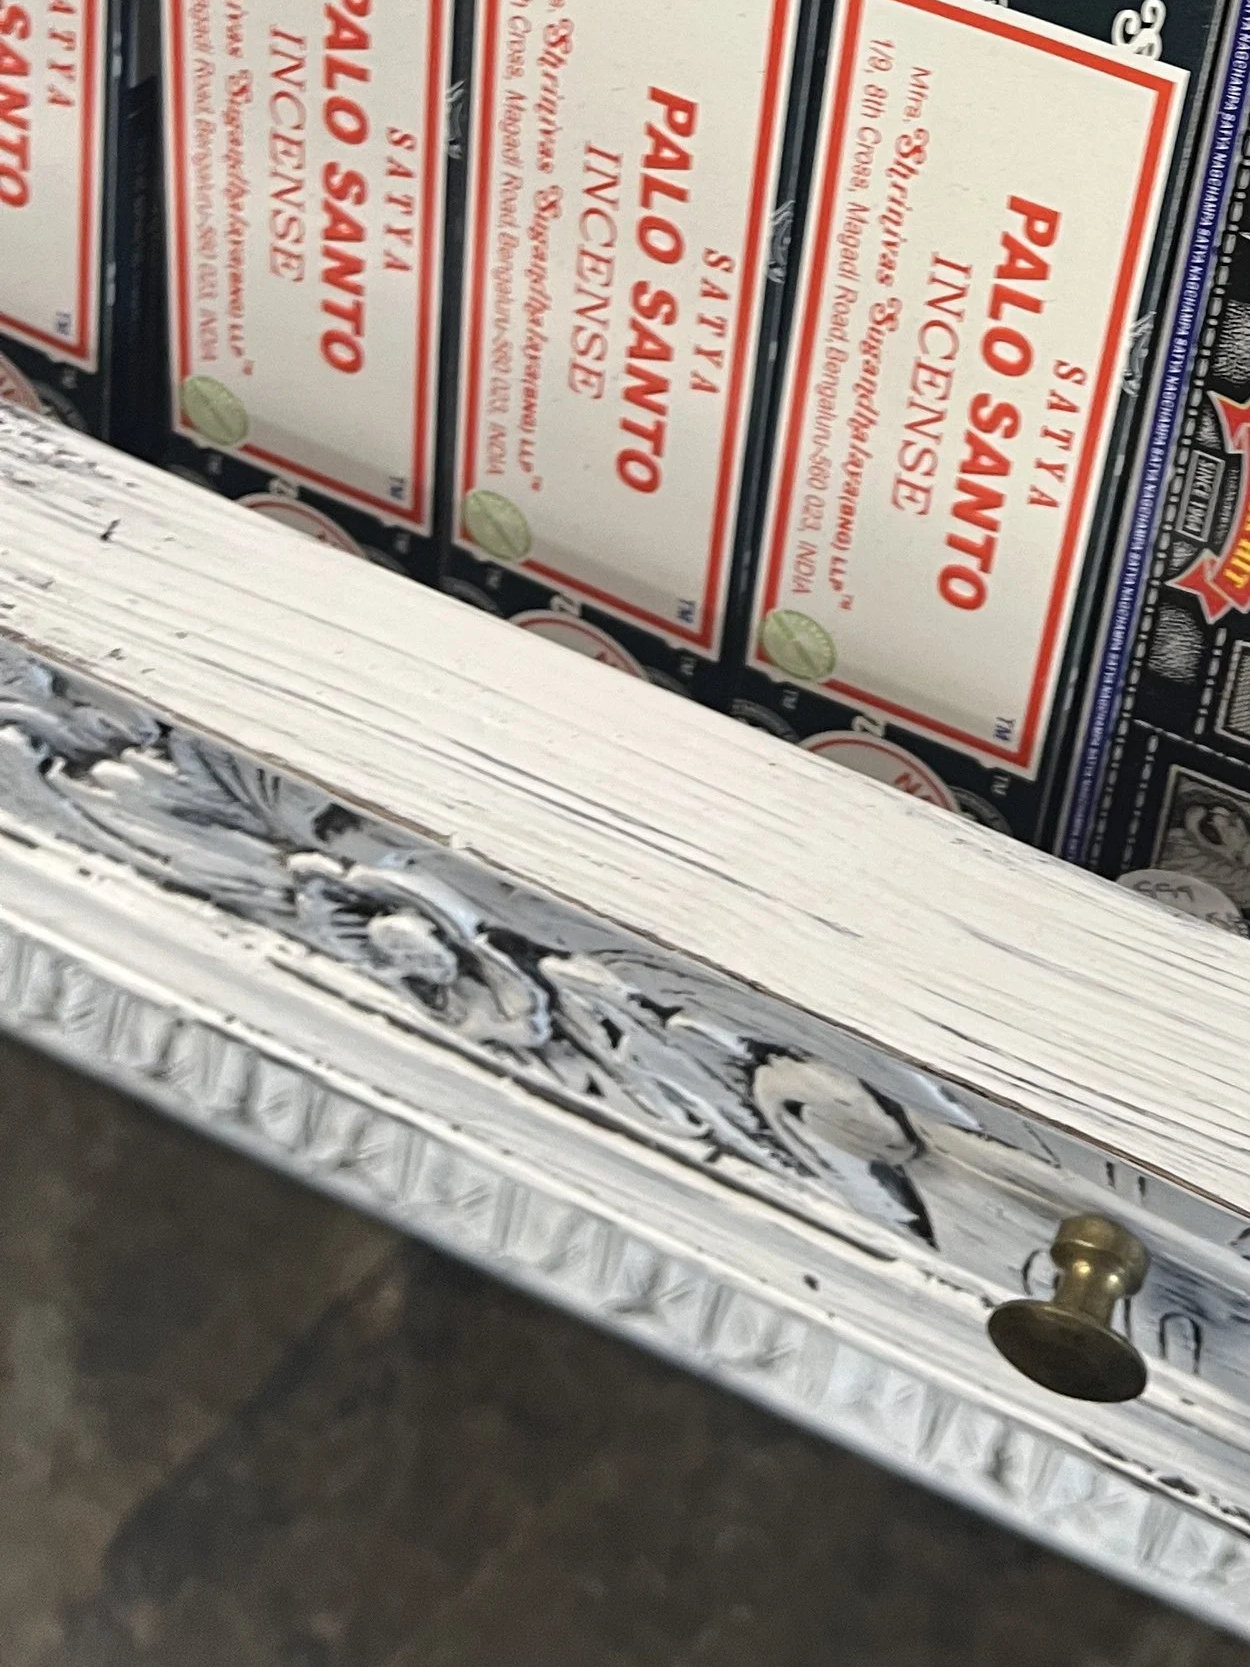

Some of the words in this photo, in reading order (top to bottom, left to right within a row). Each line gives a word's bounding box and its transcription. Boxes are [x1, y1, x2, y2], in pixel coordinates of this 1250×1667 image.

[267, 22, 311, 286] INCENSE
[635, 85, 701, 265] PALO
[850, 124, 881, 191] Cross,
[862, 82, 888, 119] 8th
[319, 159, 372, 377] SANTO
[381, 125, 418, 274] SATYA
[567, 138, 625, 400] INCENSE
[837, 200, 872, 282] Magadi
[875, 126, 928, 286] Shrinivas
[688, 245, 737, 396] SATYA
[980, 195, 1061, 377] PALO
[613, 279, 680, 495] SANTO
[890, 253, 972, 516] INCENSE
[1026, 359, 1087, 509] SATYA
[937, 392, 1021, 611] SANTO
[1187, 459, 1216, 497] SINCE
[791, 541, 817, 596] INDIA
